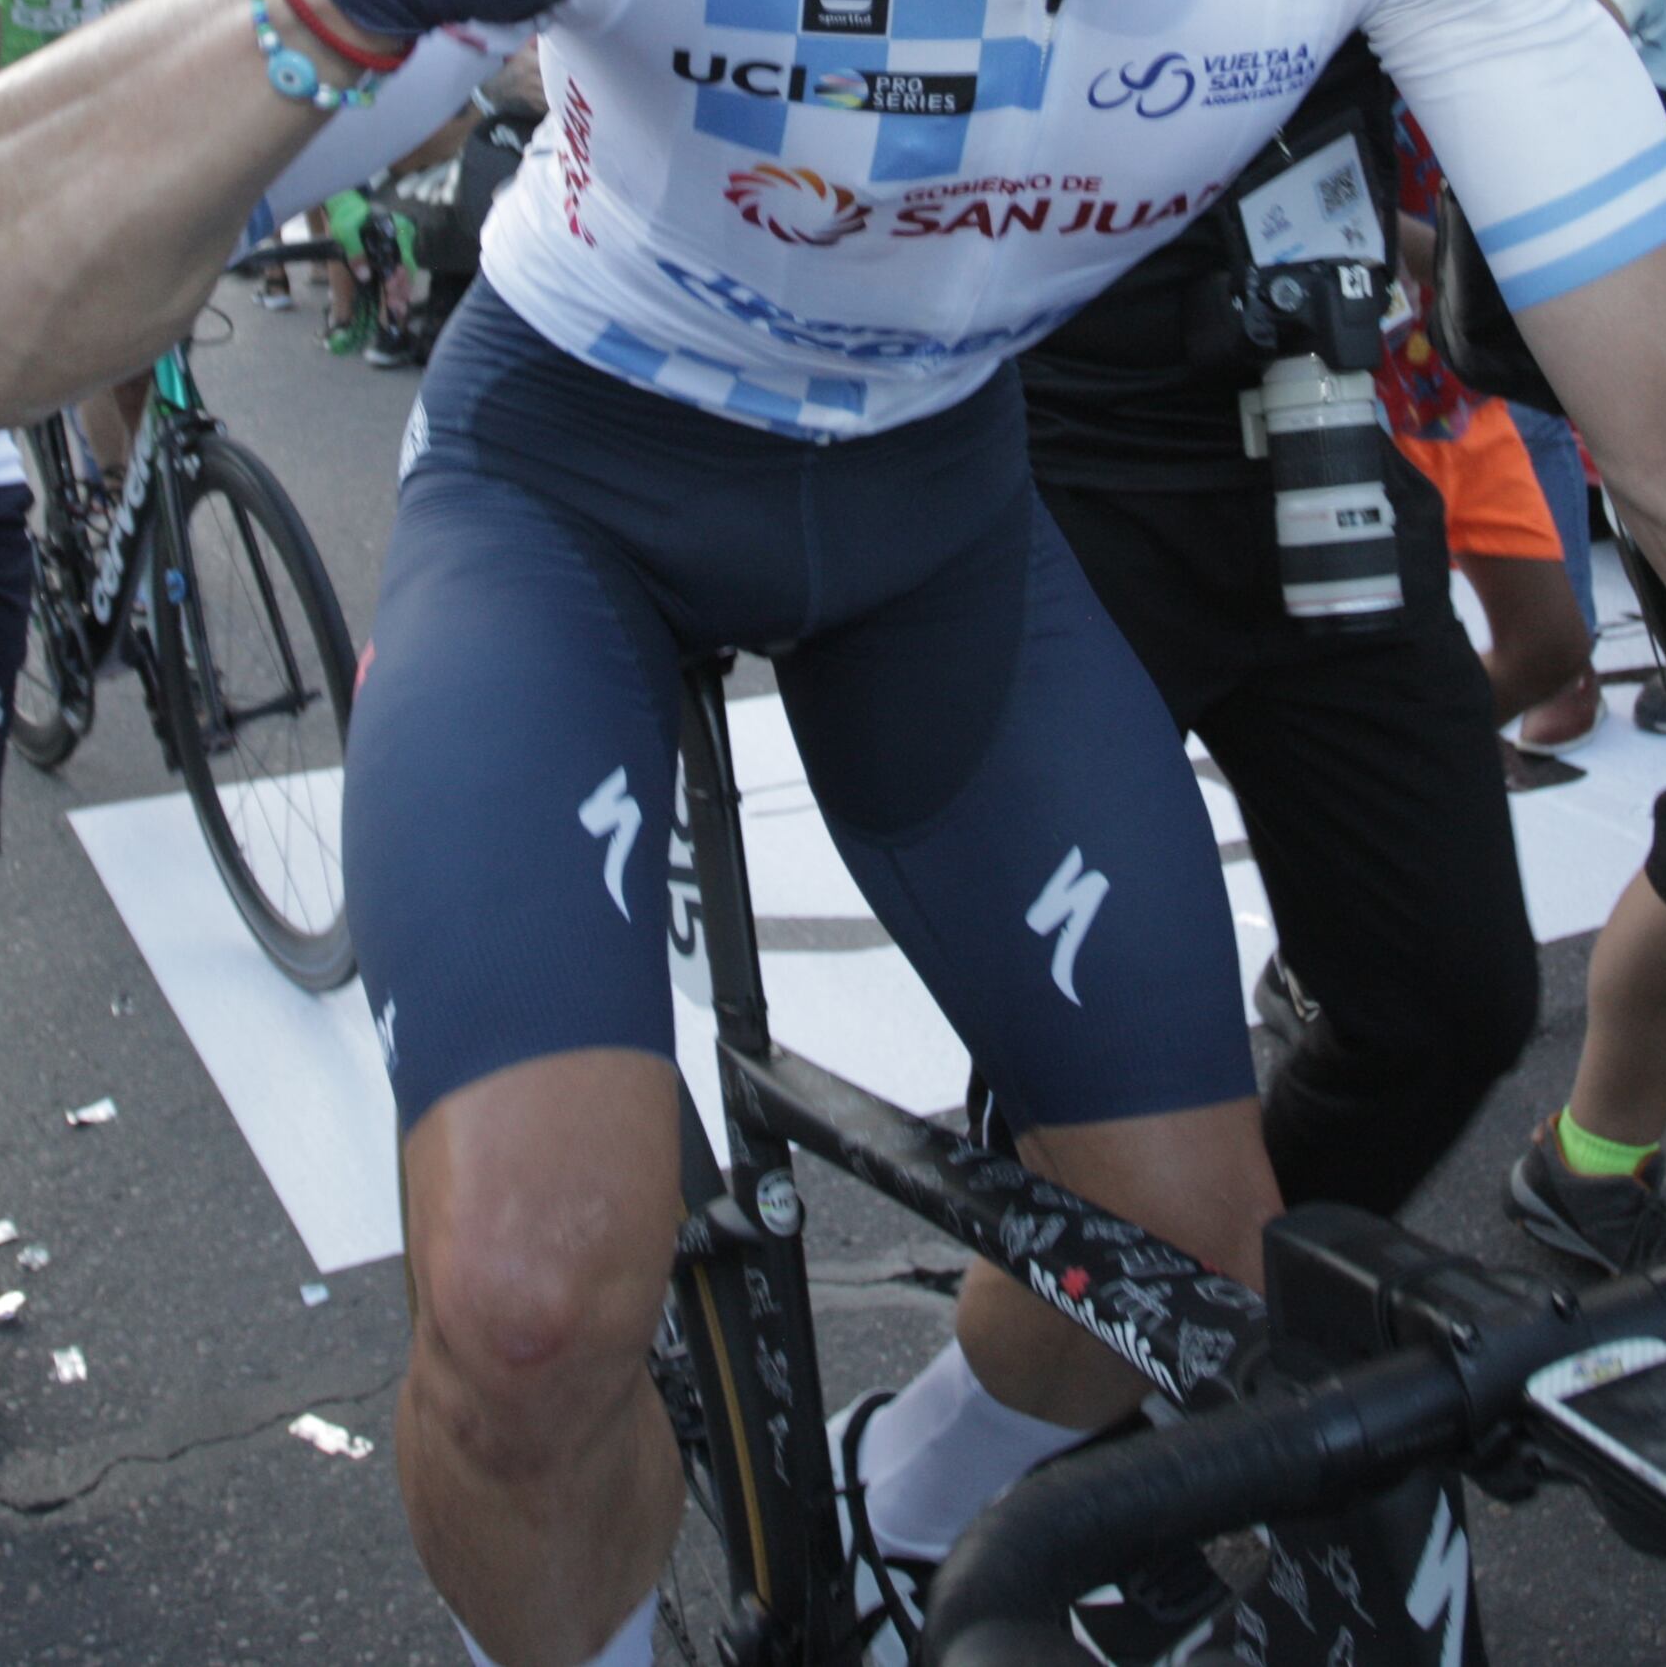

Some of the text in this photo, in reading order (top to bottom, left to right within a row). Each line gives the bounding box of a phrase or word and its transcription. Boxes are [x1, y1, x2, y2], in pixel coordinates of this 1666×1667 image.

[818, 12, 873, 27] sportful
[1203, 47, 1289, 75] VUELTA
[672, 49, 807, 103] UCI
[876, 76, 923, 94] PRO
[1208, 71, 1260, 92] SAN
[872, 93, 957, 112] SERIES
[903, 175, 1103, 203] GOBIERNO DE
[890, 197, 1052, 240] SAN
